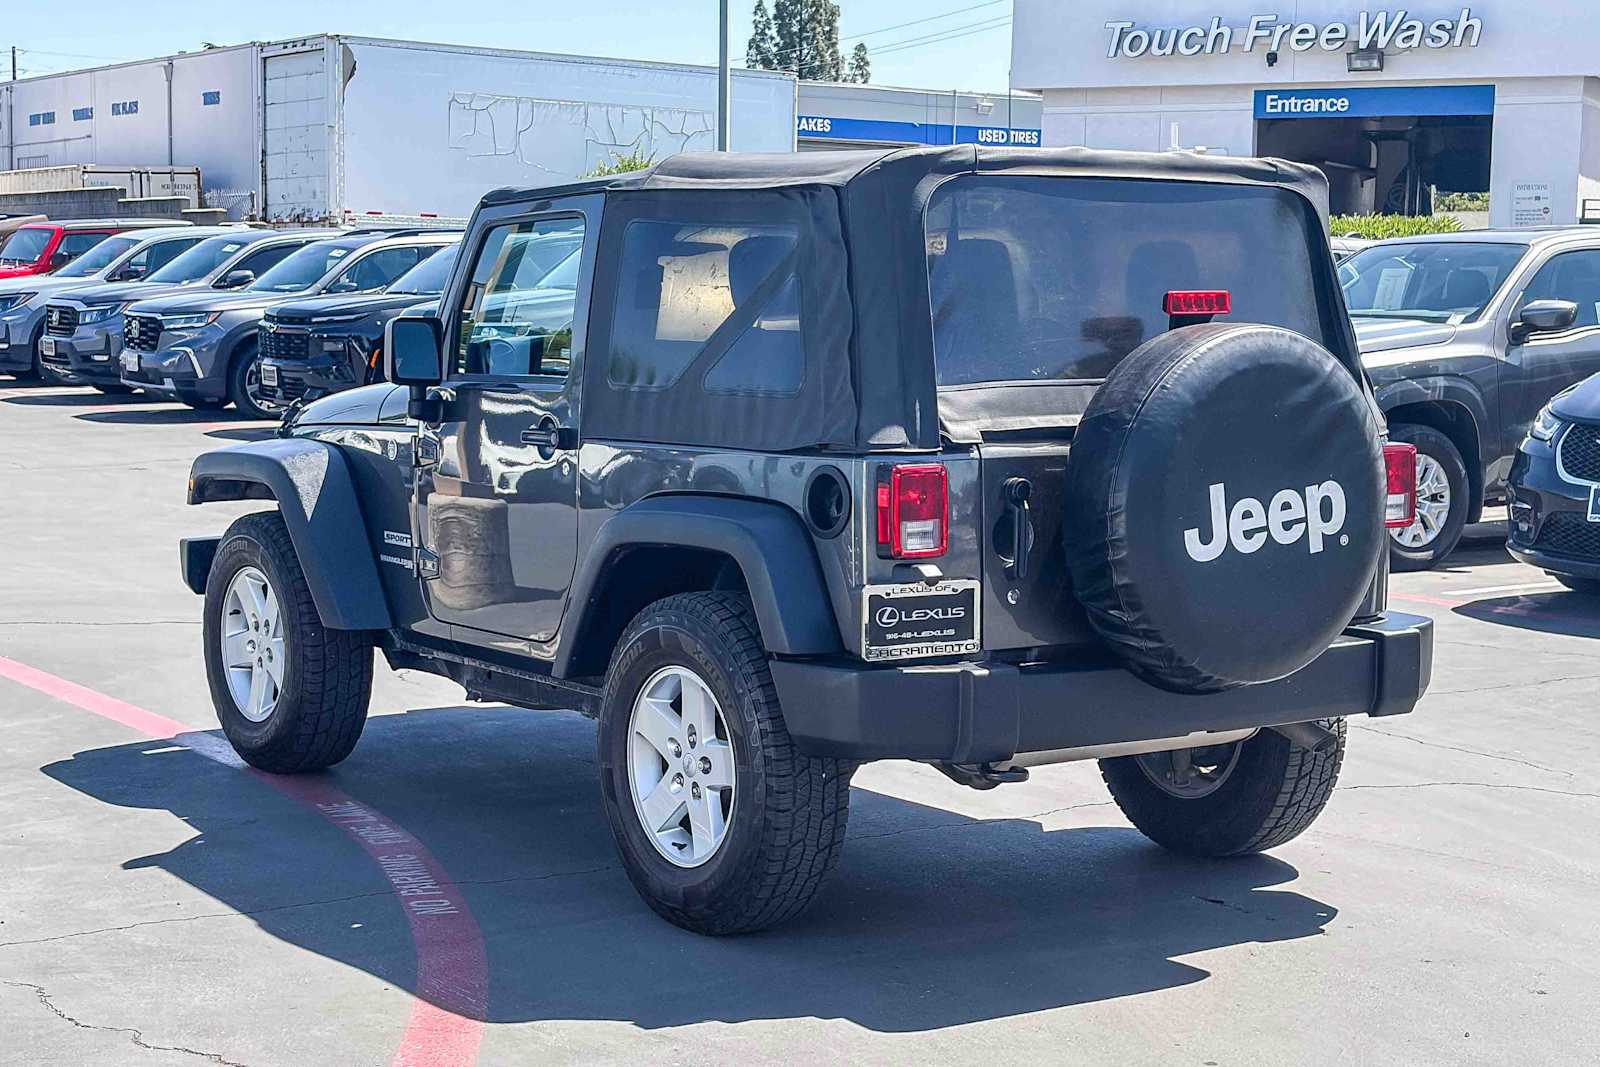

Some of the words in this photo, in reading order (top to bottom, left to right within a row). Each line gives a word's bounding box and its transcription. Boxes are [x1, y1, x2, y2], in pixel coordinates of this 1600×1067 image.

[1105, 16, 1233, 58] Touch
[1243, 14, 1348, 51] Free
[1358, 8, 1483, 49] Wash
[1265, 94, 1349, 113] Entrance
[796, 117, 832, 132] AKES
[978, 129, 1008, 143] USED
[1010, 130, 1039, 144] TIRES
[1184, 480, 1346, 562] Jeep
[386, 533, 411, 545] SPORT
[892, 586, 932, 595] LEXUS
[901, 607, 965, 621] LEXUS
[869, 643, 977, 658] SACRAMENTO
[377, 853, 444, 896] PARKING
[409, 899, 460, 915] NO
